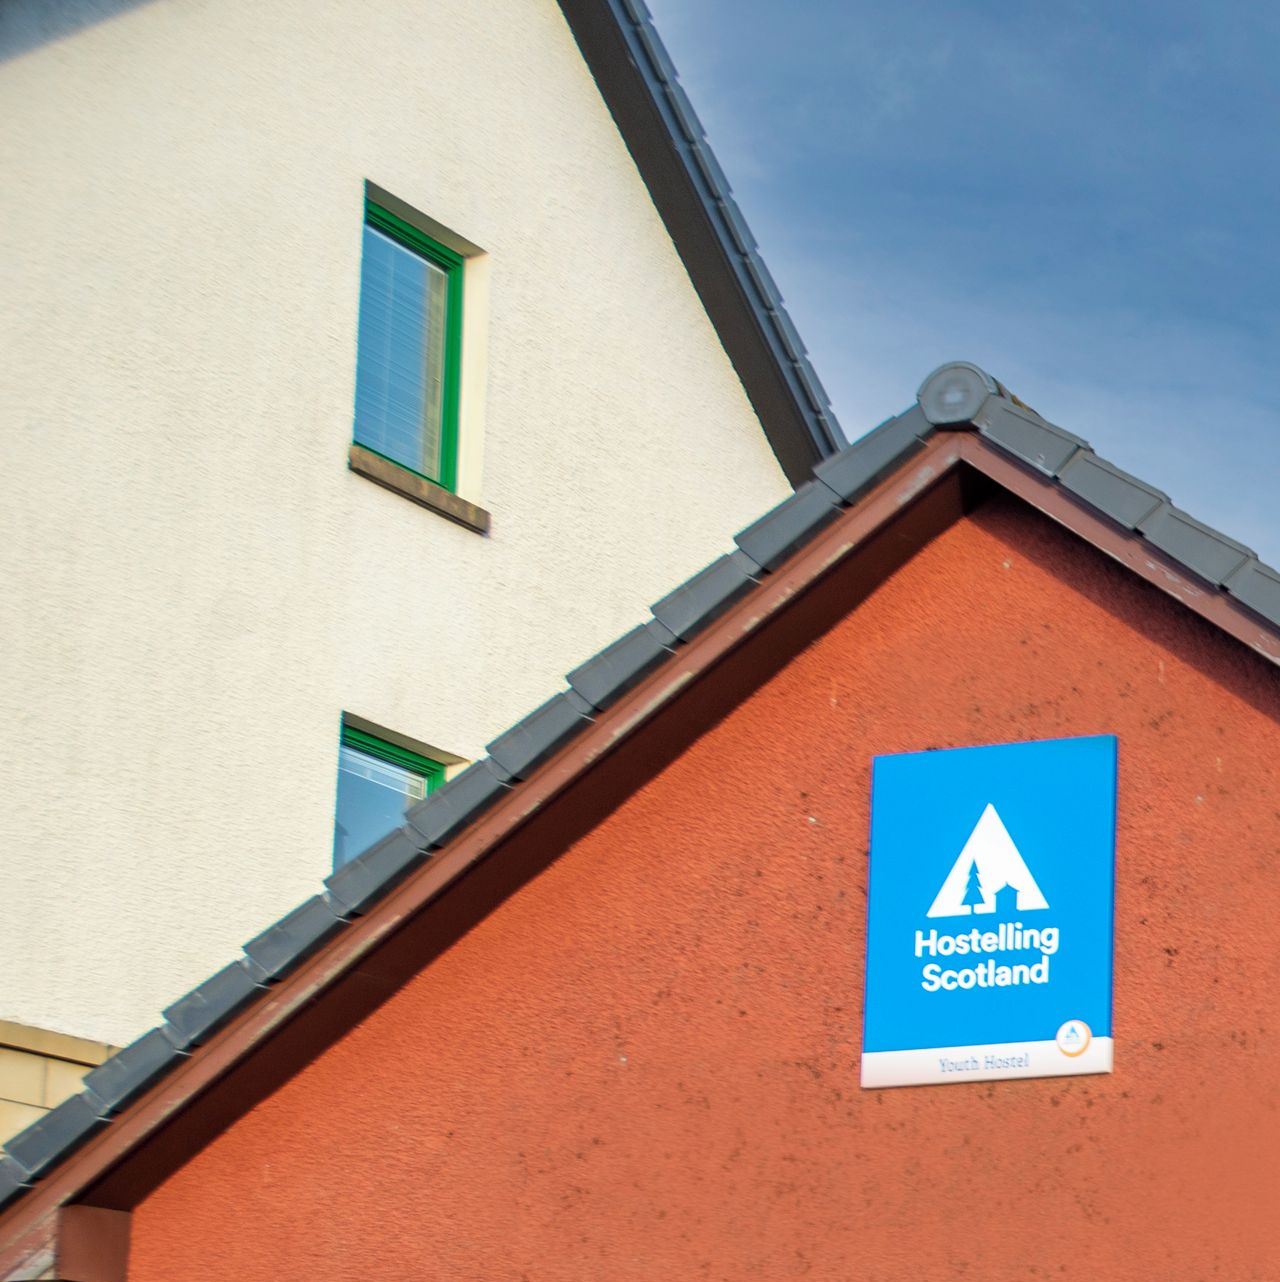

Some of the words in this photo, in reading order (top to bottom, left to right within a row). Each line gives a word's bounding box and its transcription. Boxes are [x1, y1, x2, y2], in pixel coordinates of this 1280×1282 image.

[915, 922, 1060, 957] Hostelling
[921, 956, 1050, 992] Scotland
[938, 1057, 979, 1072] Youth
[984, 1052, 1030, 1070] Hostel
